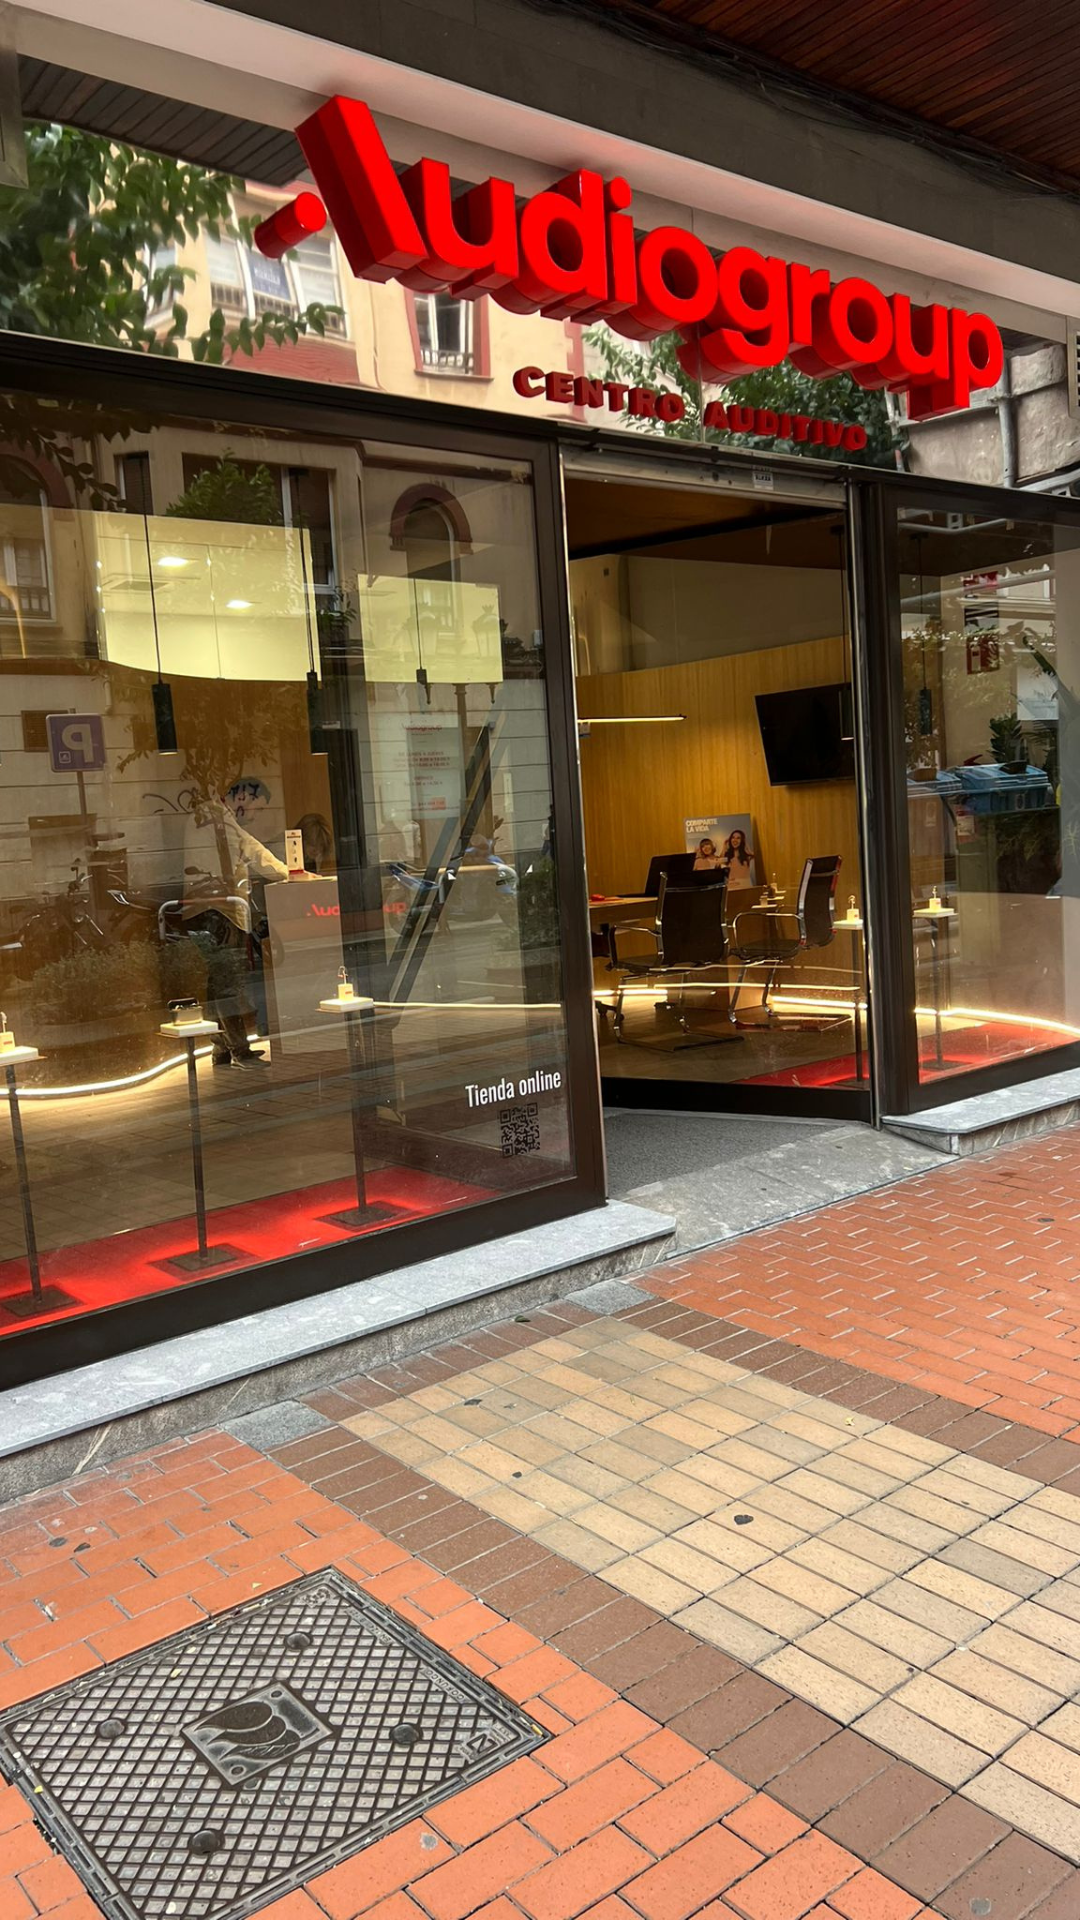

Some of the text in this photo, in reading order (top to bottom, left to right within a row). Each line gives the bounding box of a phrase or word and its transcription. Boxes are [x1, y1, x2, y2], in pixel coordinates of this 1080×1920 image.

[512, 365, 868, 452] CENTRO AUDITIVO
[686, 818, 718, 826] COMPARTE
[465, 1070, 562, 1108] Tienda online
